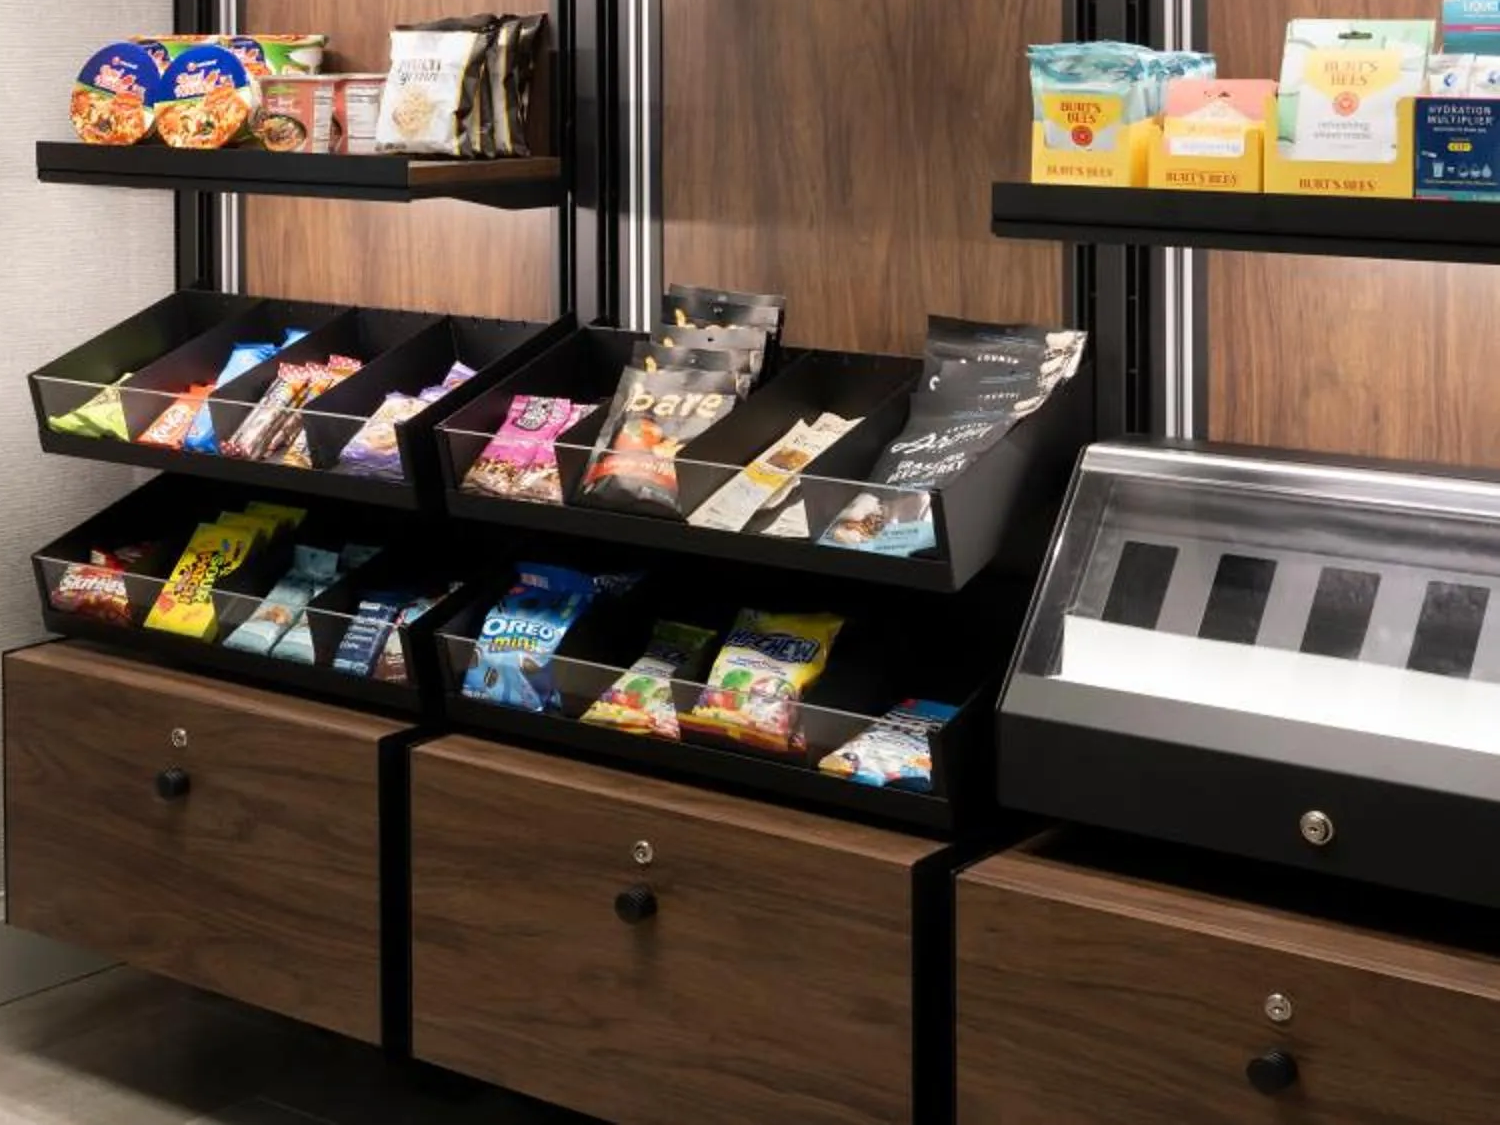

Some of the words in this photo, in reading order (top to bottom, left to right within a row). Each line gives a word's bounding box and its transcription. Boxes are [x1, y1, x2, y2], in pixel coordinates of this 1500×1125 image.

[627, 383, 724, 419] bare
[483, 617, 555, 641] OREO
[491, 636, 540, 654] mini
